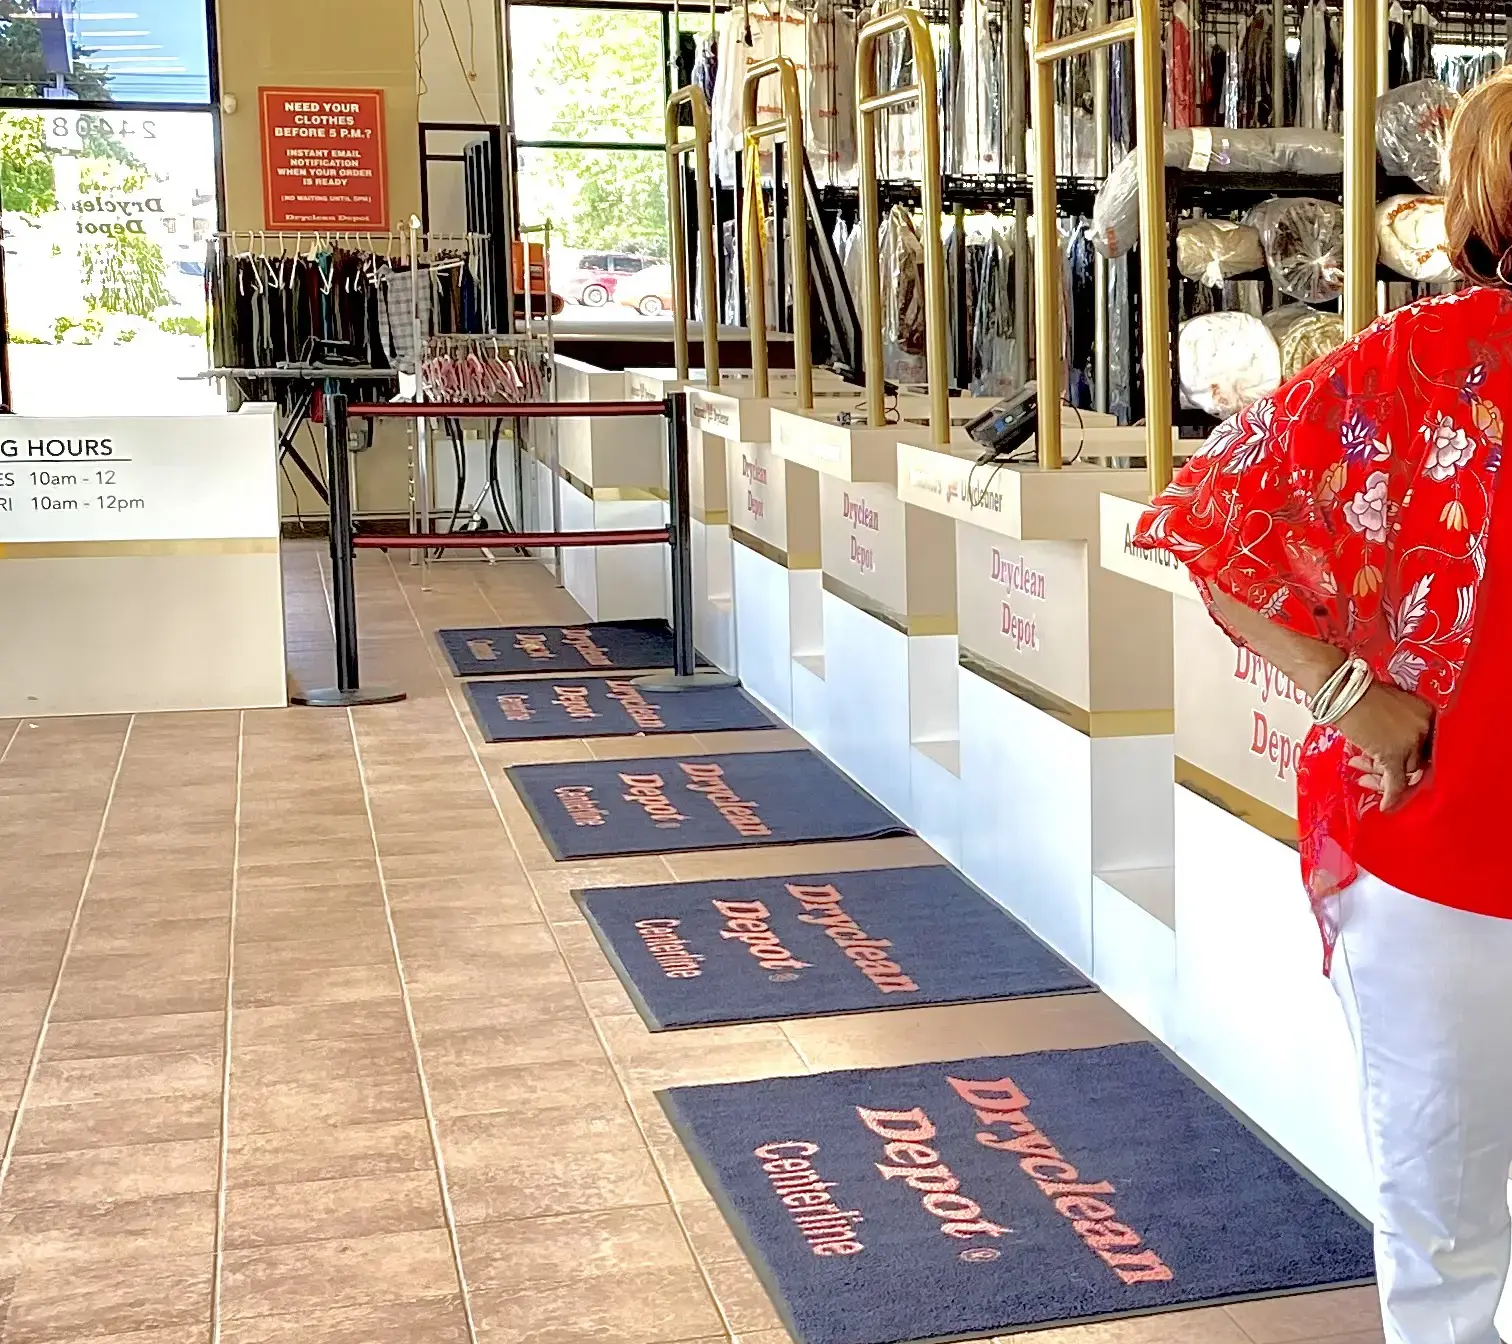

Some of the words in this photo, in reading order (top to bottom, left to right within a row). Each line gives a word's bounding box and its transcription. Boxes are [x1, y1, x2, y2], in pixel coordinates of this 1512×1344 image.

[284, 102, 319, 112] NEED
[323, 103, 359, 113] YOUR
[294, 115, 354, 126] CLOTHES
[274, 127, 326, 137] BEFORE
[329, 128, 337, 138] 5
[286, 149, 329, 158] INSTANT
[331, 150, 361, 158] EMAIL
[290, 158, 359, 167] NOTIFICATION
[277, 168, 307, 176] WHEN
[309, 168, 337, 177] YOUR
[339, 169, 372, 177] ORDER
[315, 178, 348, 186] READY
[28, 439, 113, 457] HOURS
[30, 471, 77, 485] 10am
[96, 470, 116, 485] 12
[31, 496, 78, 510] 10am
[97, 495, 145, 512] 12pm
[843, 492, 879, 531] Dryclean
[990, 546, 1046, 600] Dryclean
[1250, 711, 1302, 779] Depo
[678, 762, 772, 837] Dryclean
[784, 882, 919, 994] Dryclean
[634, 917, 706, 979] Centerline
[946, 1076, 1174, 1286] Dryclean
[754, 1140, 864, 1257] Centerline
